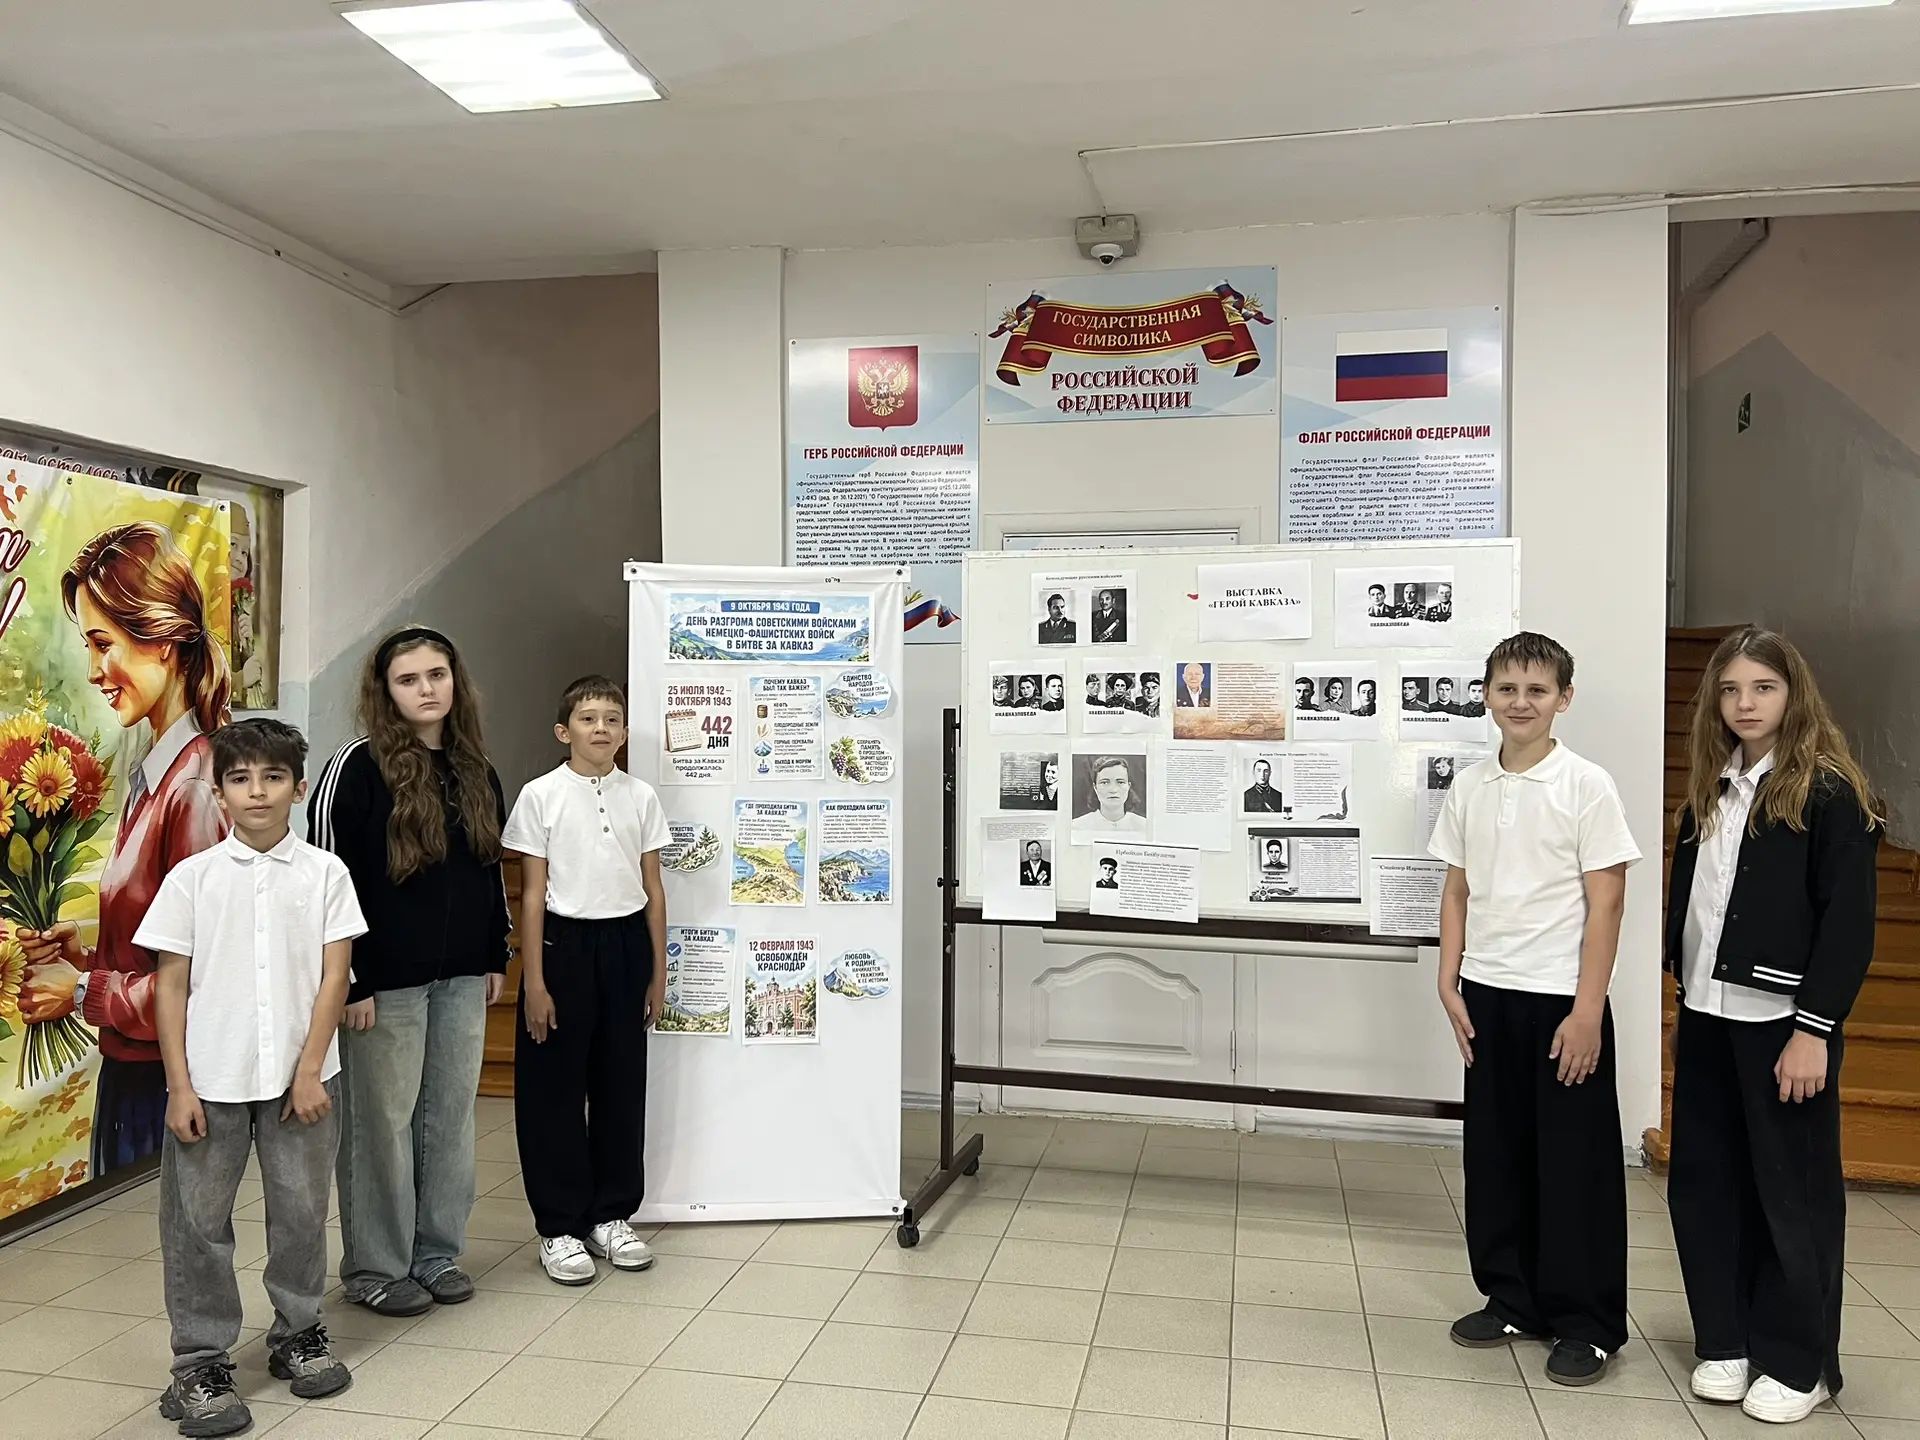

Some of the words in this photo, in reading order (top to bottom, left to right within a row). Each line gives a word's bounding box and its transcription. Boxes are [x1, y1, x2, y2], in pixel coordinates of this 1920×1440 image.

[1052, 304, 1202, 331] ГОСУДАРСТВЕННАЯ
[1073, 330, 1172, 347] СИМВОЛИКА
[1052, 362, 1198, 390] РОССИЙСКОЙ
[1057, 391, 1192, 416] ФЕДЕРАЦИИ
[1298, 431, 1332, 444] ФЛАГ
[1335, 427, 1412, 443] РОССИЙСКОЙ
[1416, 425, 1490, 441] ФЕДЕРАЦИИ
[804, 448, 828, 459] ГЕРБ
[831, 445, 897, 459] РОССИЙСКОЙ
[900, 444, 963, 458] ФЕДЕРАЦИИ
[1226, 588, 1282, 597] ВЫСТАВКА
[730, 602, 736, 610] 9
[738, 602, 771, 611] ОКТЯБРЯ
[772, 602, 790, 611] 1943
[792, 603, 810, 612] ГОДА
[1208, 599, 1246, 608] «ГЕРОЙ
[1249, 598, 1301, 607] КАВКАЗА»
[686, 616, 708, 626] ДЕНЬ
[710, 617, 754, 626] РАЗГРОМА
[756, 617, 809, 627] СОВЕТСКИМИ
[811, 617, 856, 628] ВОЙСКАМИ
[706, 628, 805, 639] НЕМЕЦКО-ФАШИСТСКИХ
[808, 628, 834, 639] ВОЙСК
[727, 640, 732, 649] В
[736, 640, 763, 650] БИТВЕ
[766, 641, 777, 650] ЗА
[780, 641, 814, 650] КАВКАЗ
[668, 686, 678, 695] 25
[680, 686, 704, 695] ИЮЛЯ
[706, 686, 725, 695] 1942
[668, 696, 673, 706] 9
[675, 696, 711, 706] ОКТЯБРЯ
[713, 697, 731, 706] 1943
[701, 716, 732, 734] 442
[707, 736, 729, 749] ДНЯ
[749, 941, 758, 951] 12
[760, 940, 795, 951] ФЕВРАЛЯ
[796, 940, 814, 950] 1943
[755, 952, 808, 963] ОСВОБОЖДЁН
[758, 961, 806, 972] КРАСНОДАР
